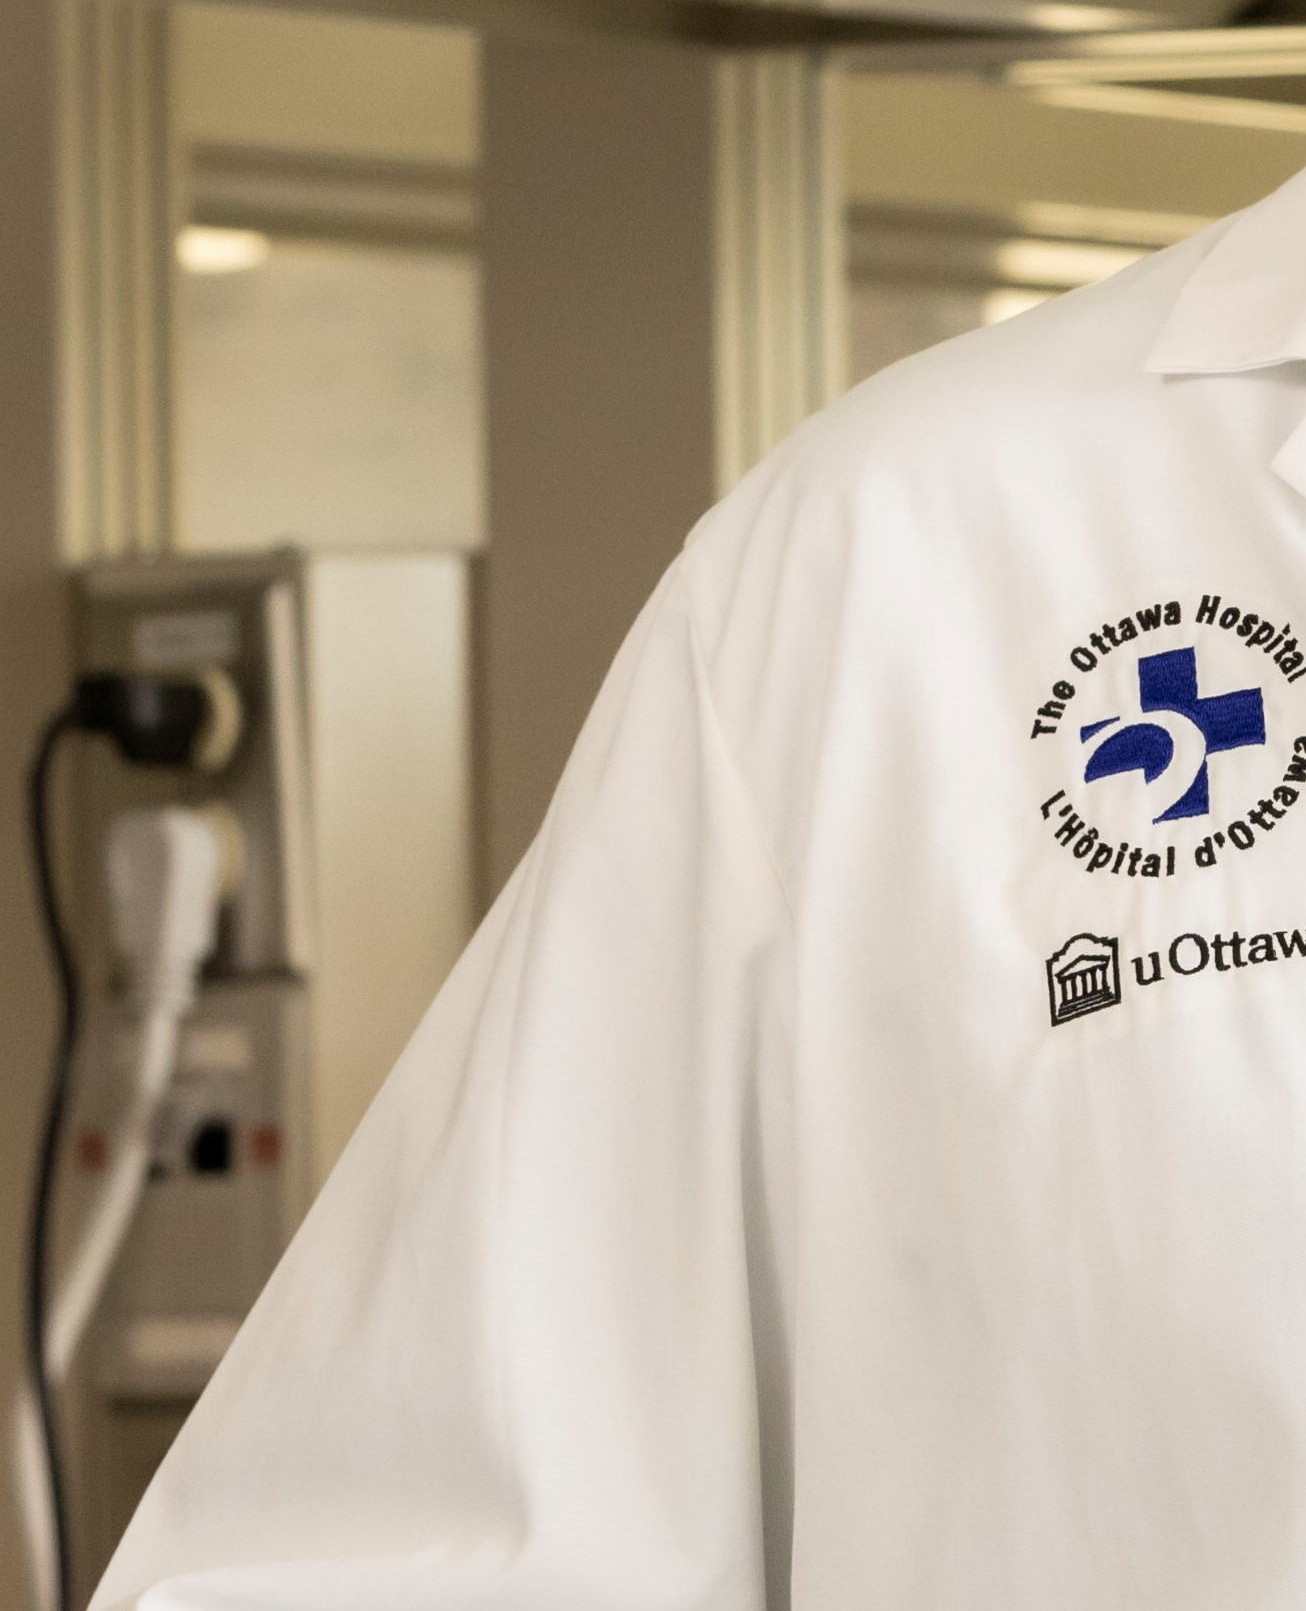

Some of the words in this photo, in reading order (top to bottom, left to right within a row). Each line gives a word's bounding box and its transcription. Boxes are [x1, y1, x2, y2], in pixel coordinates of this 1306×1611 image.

[1031, 681, 1075, 739] The
[1071, 602, 1182, 673] Ottawa
[1041, 790, 1176, 878] L'Hôpital
